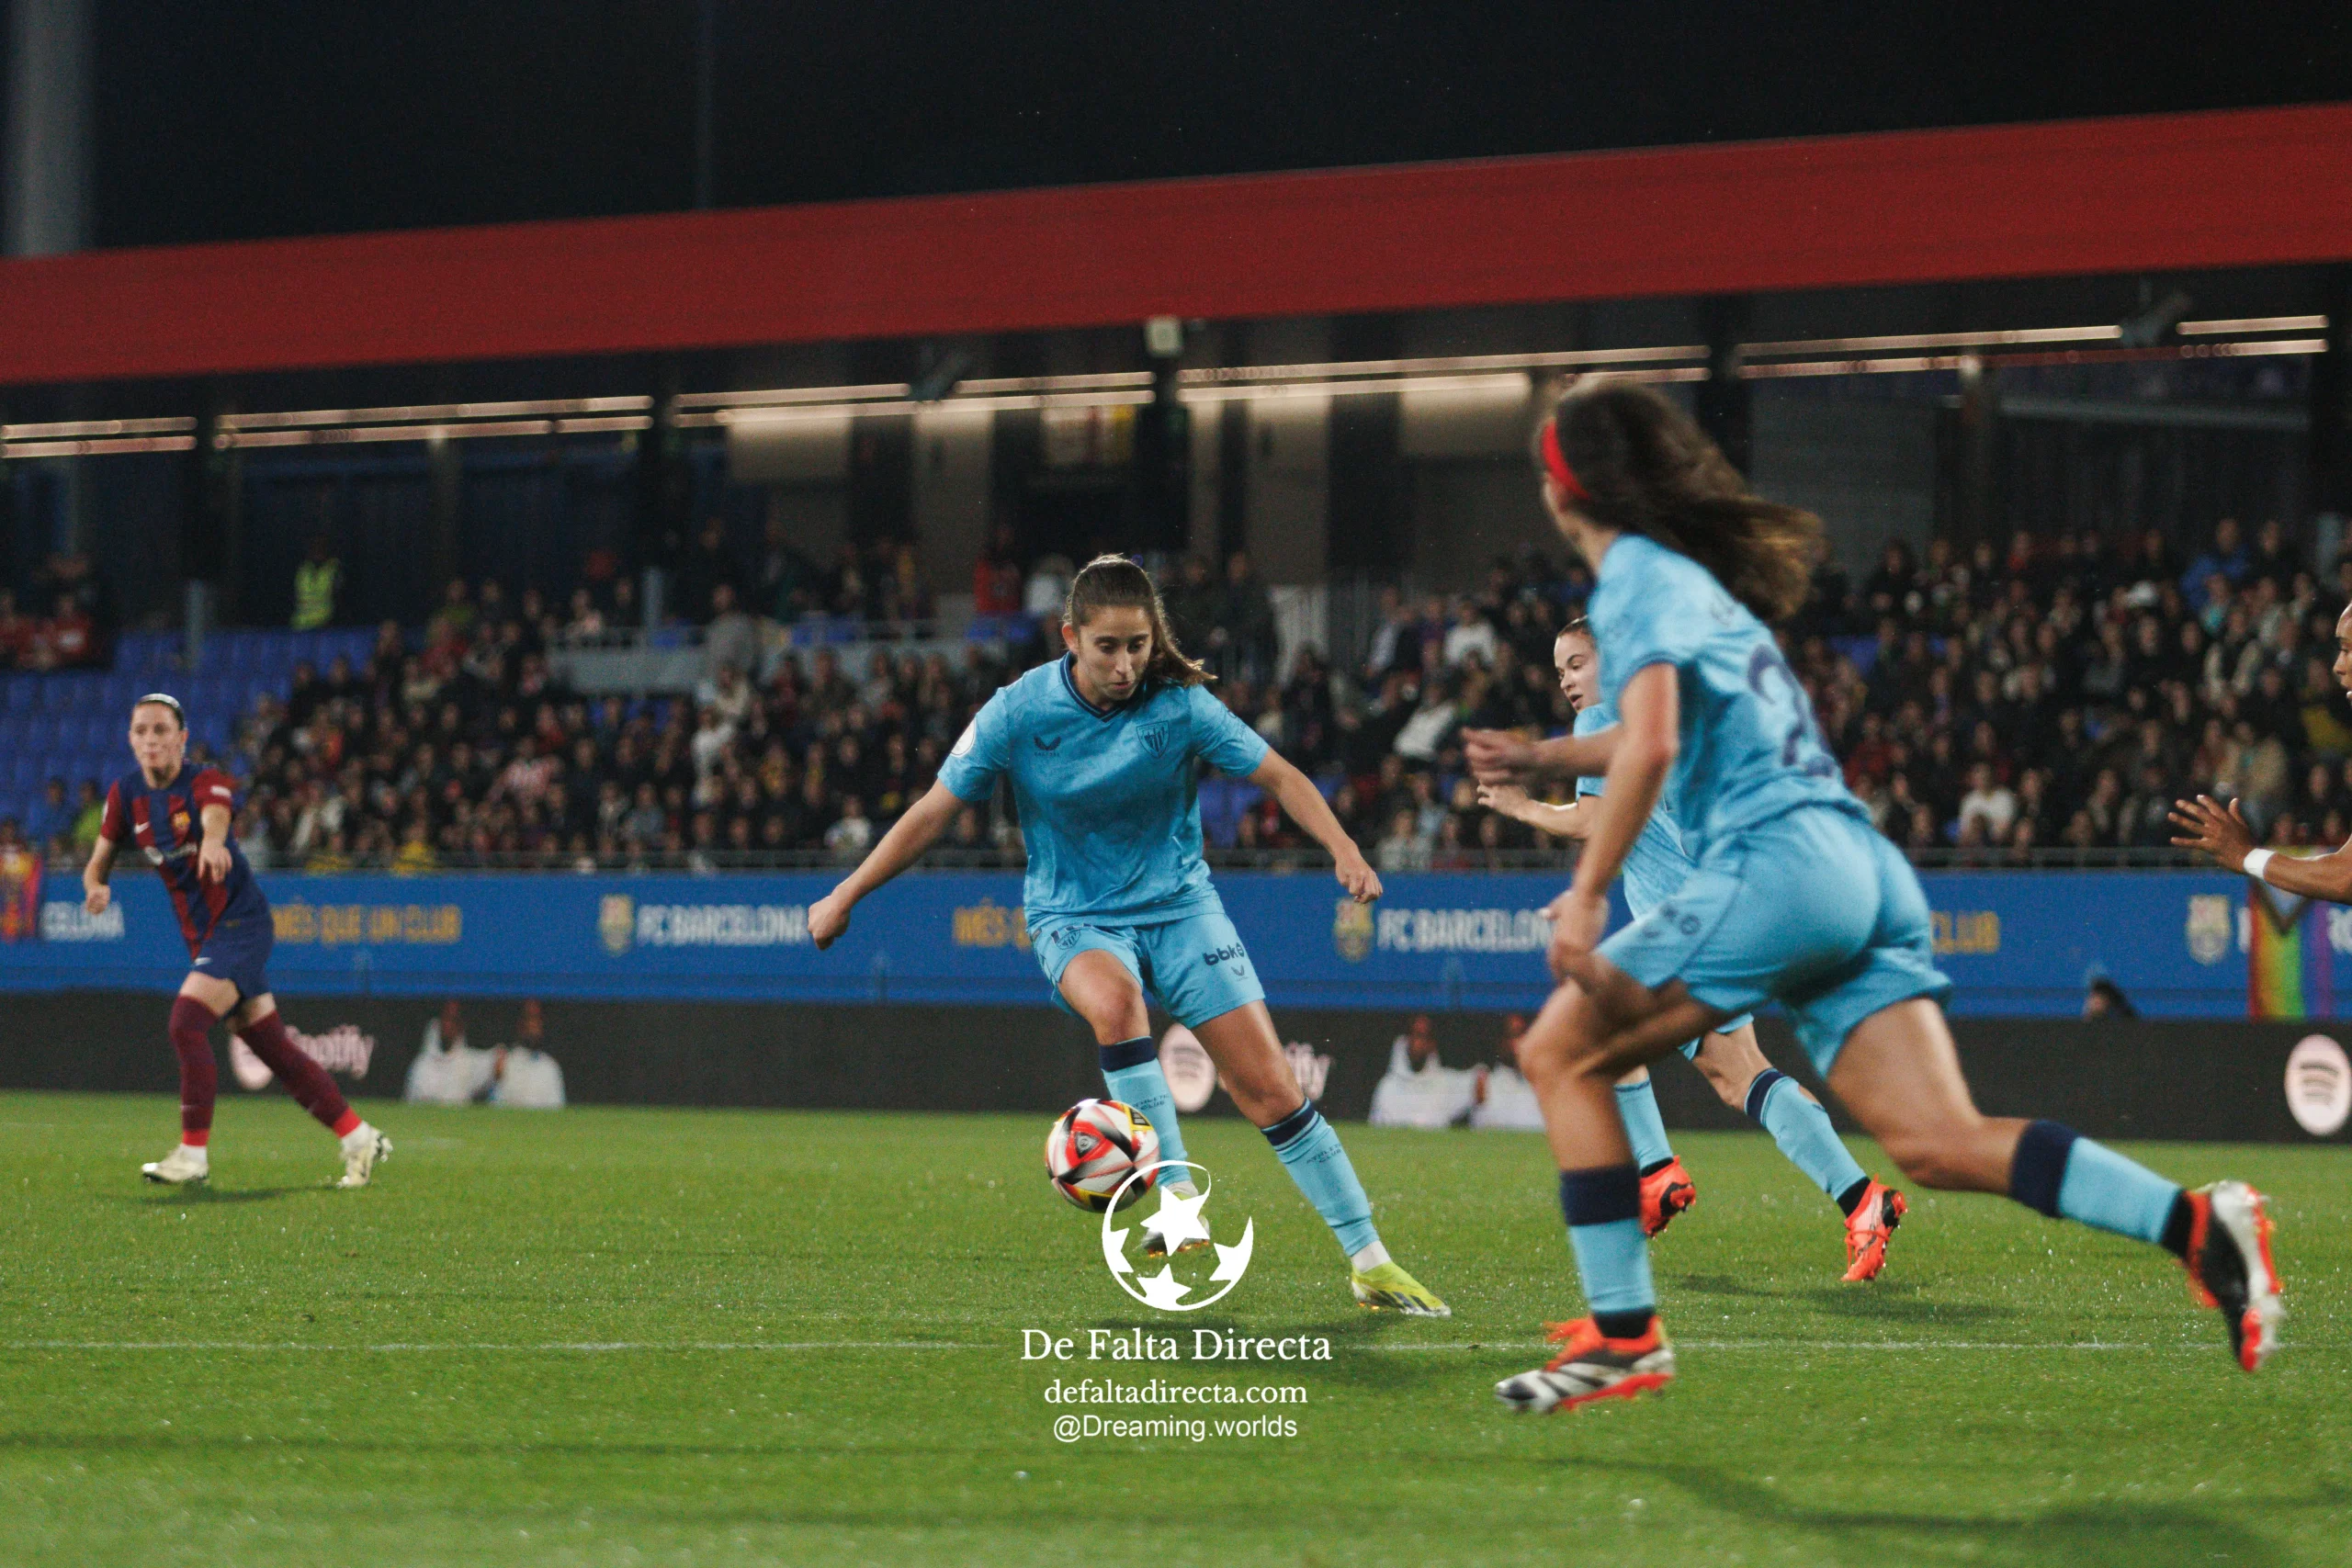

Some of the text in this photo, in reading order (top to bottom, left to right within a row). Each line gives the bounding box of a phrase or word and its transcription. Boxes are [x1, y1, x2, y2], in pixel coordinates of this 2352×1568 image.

[320, 904, 361, 950] QUE
[368, 904, 402, 944] UN
[404, 903, 460, 944] CLUB
[637, 904, 670, 945] FC
[952, 897, 1009, 947] MÉS
[1377, 908, 1414, 952] FC
